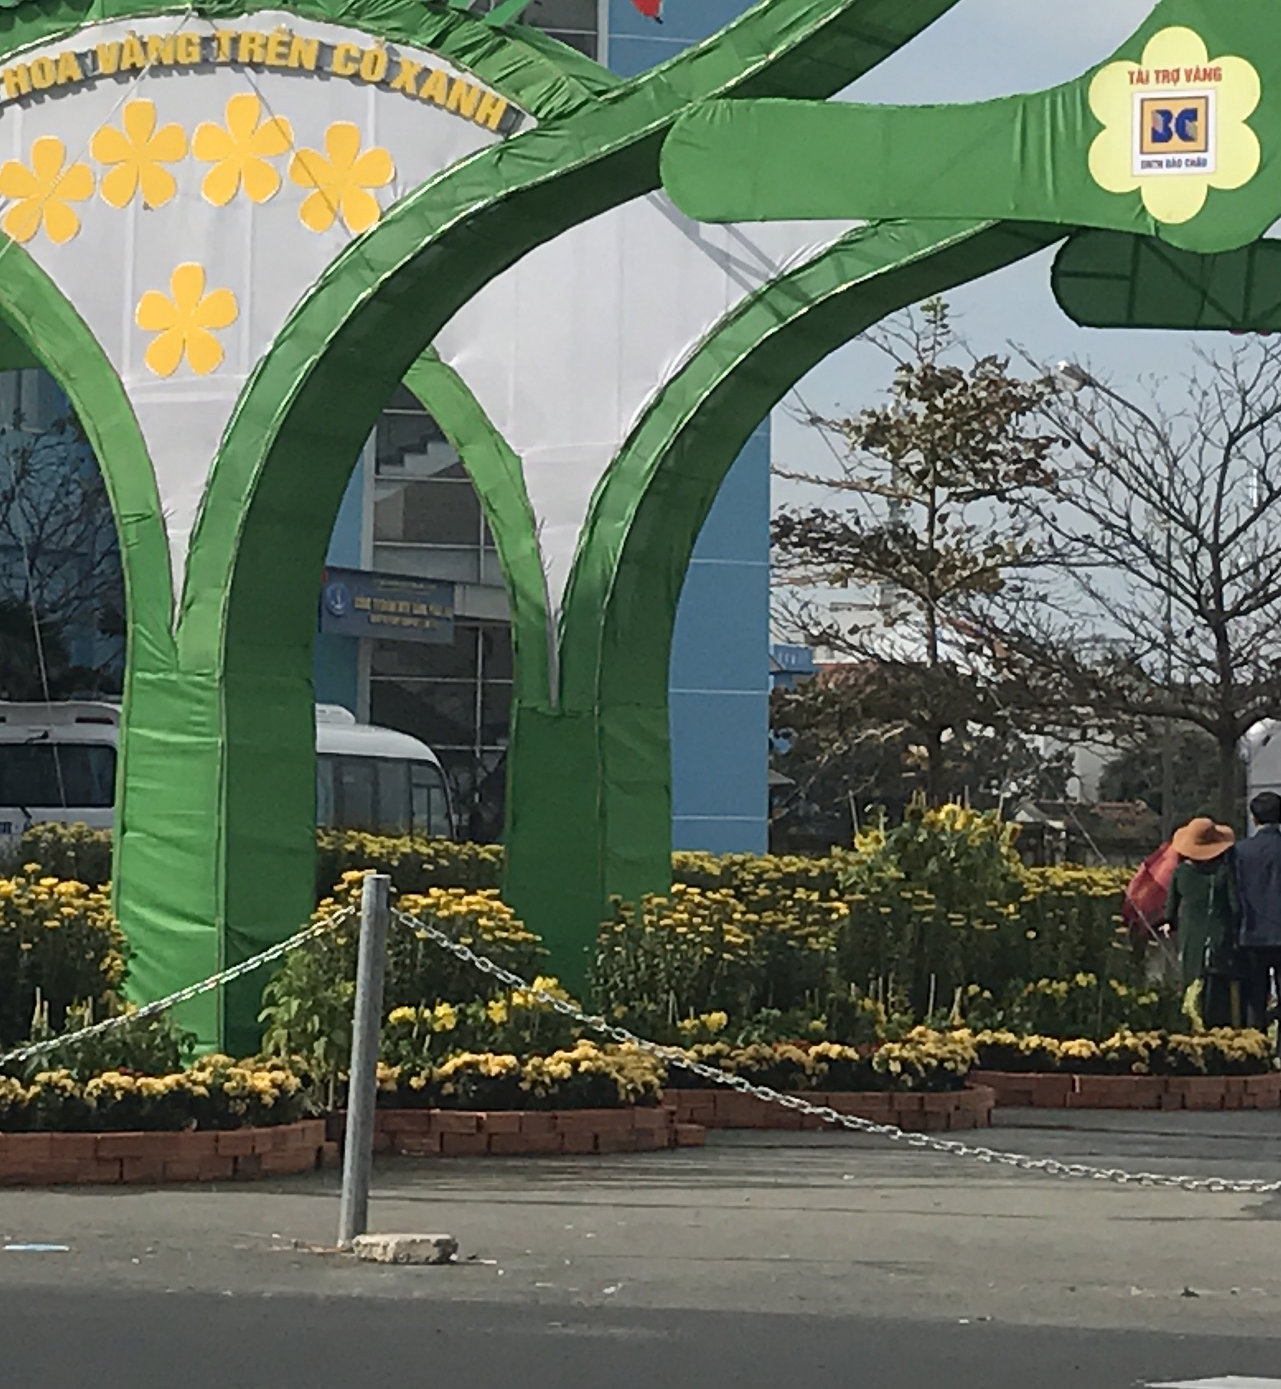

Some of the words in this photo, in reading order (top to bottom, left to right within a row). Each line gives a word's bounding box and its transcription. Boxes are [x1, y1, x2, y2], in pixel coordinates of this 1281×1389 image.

[2, 50, 84, 99] HOA
[95, 29, 202, 75] VÀNG
[214, 23, 321, 71] TRÊN
[392, 58, 509, 133] XANH
[1127, 67, 1150, 85] TÀI
[1154, 66, 1181, 86] TRỢ
[1184, 64, 1223, 82] VÀNG
